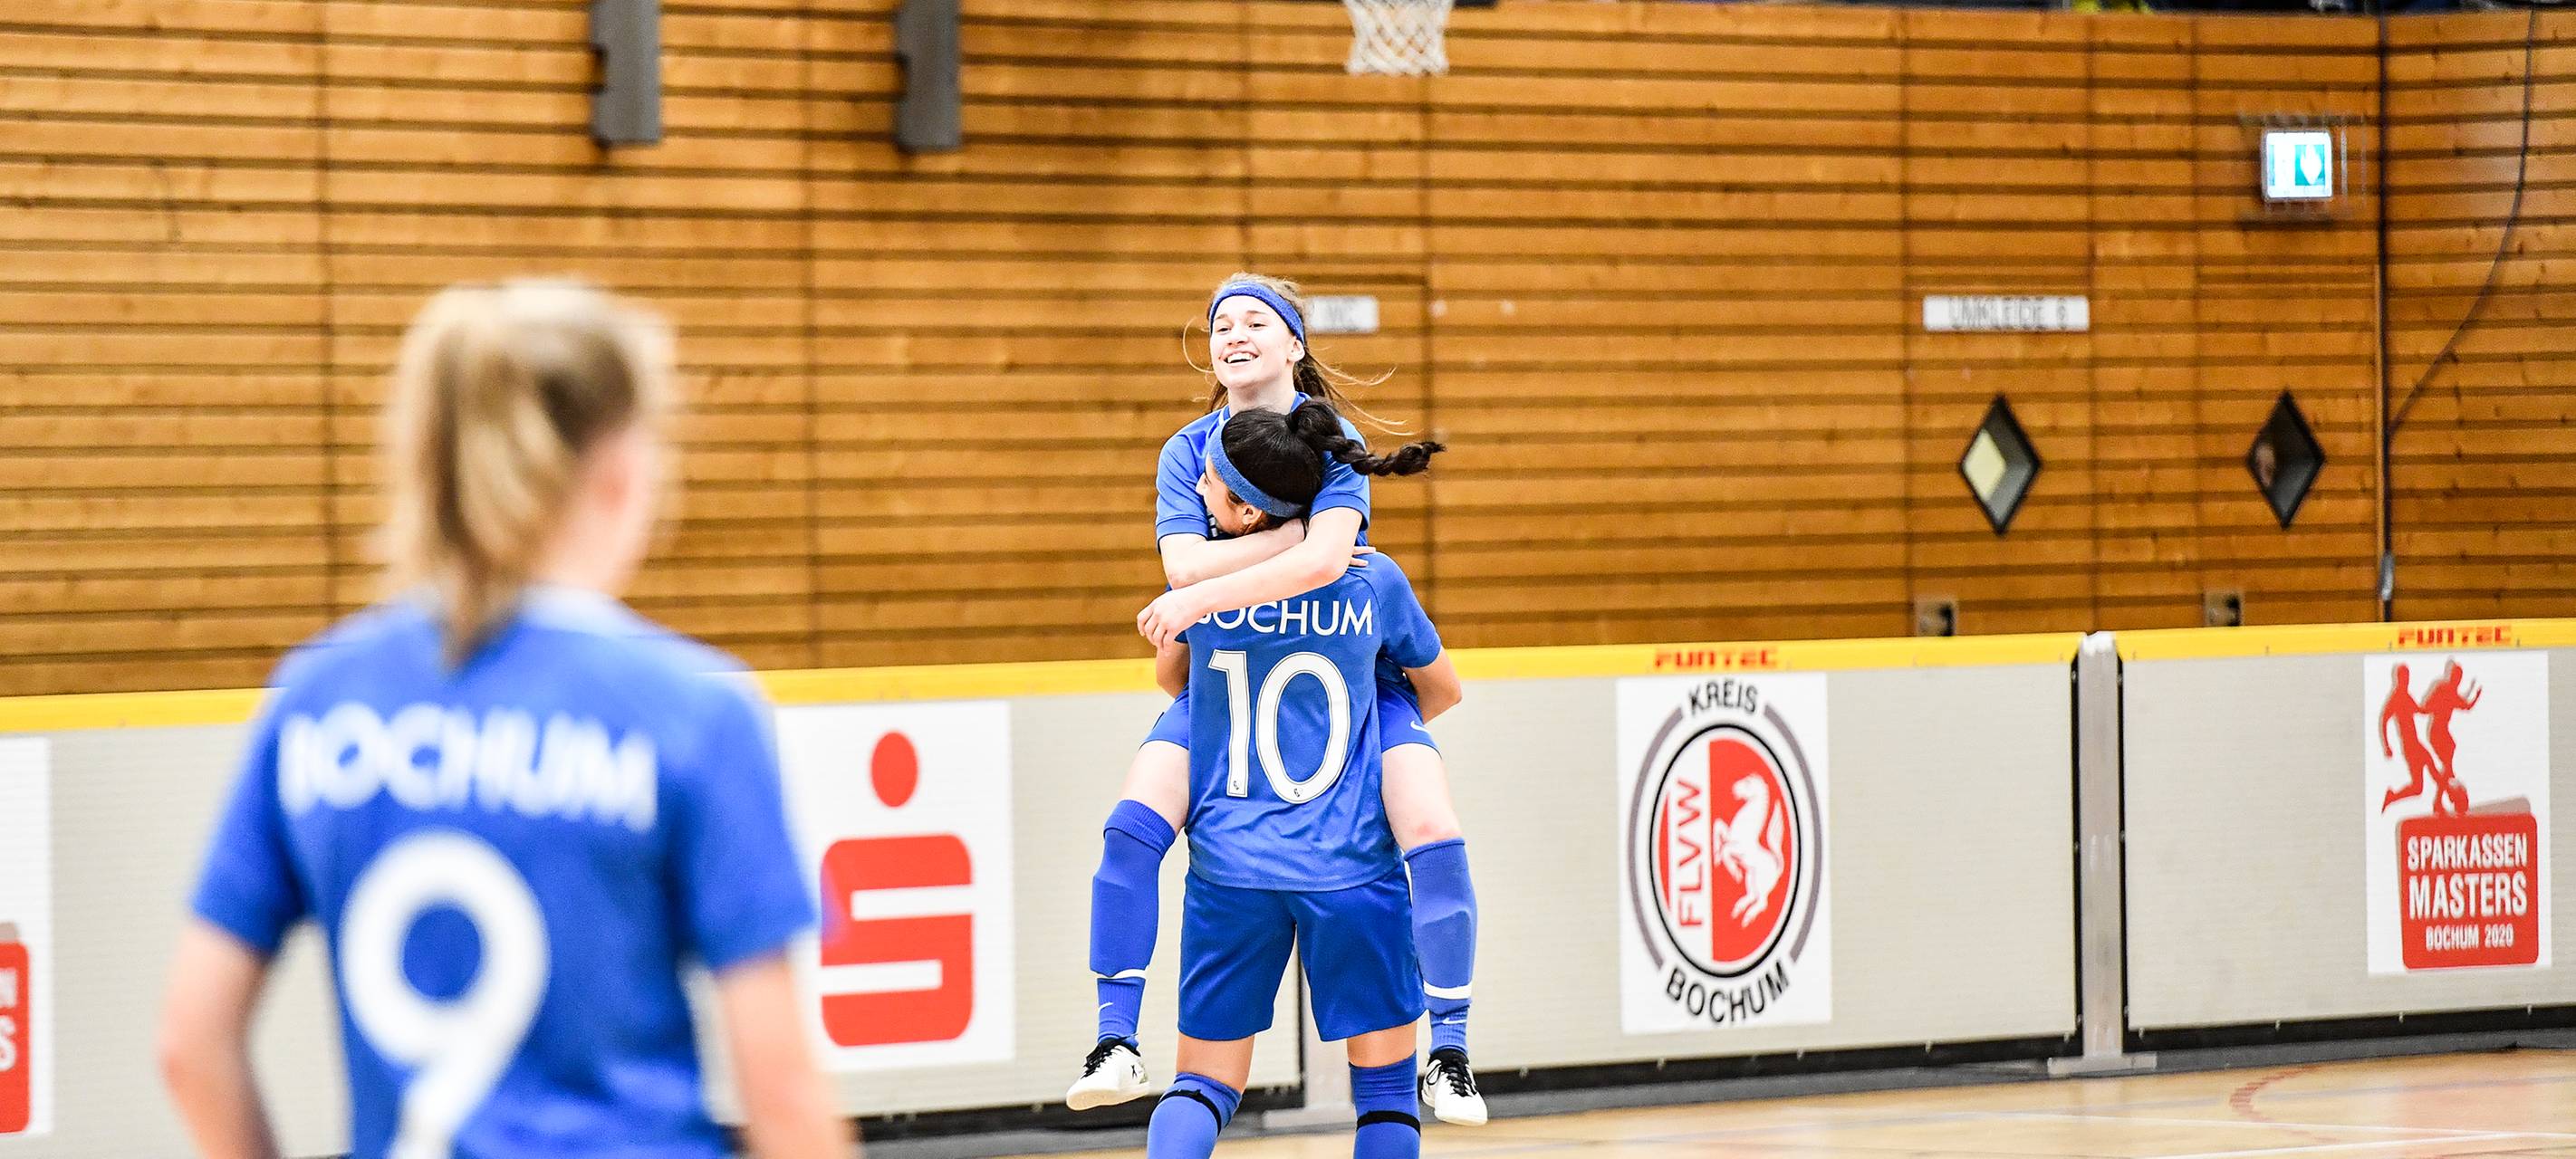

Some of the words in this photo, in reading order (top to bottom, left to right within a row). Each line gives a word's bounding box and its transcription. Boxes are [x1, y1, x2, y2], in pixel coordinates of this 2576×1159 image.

[1197, 599, 1373, 637] OCHUM
[1688, 677, 1758, 716] KREIS
[1207, 648, 1351, 805] 10
[1677, 777, 1703, 929] FLVW
[2407, 832, 2528, 872] SPARKASSEN
[2408, 871, 2528, 921] MASTERS
[2425, 924, 2479, 953] BOCHUM
[2485, 924, 2514, 950] 2020
[341, 831, 549, 1159] 9
[1666, 962, 1791, 1023] BOCHUM
